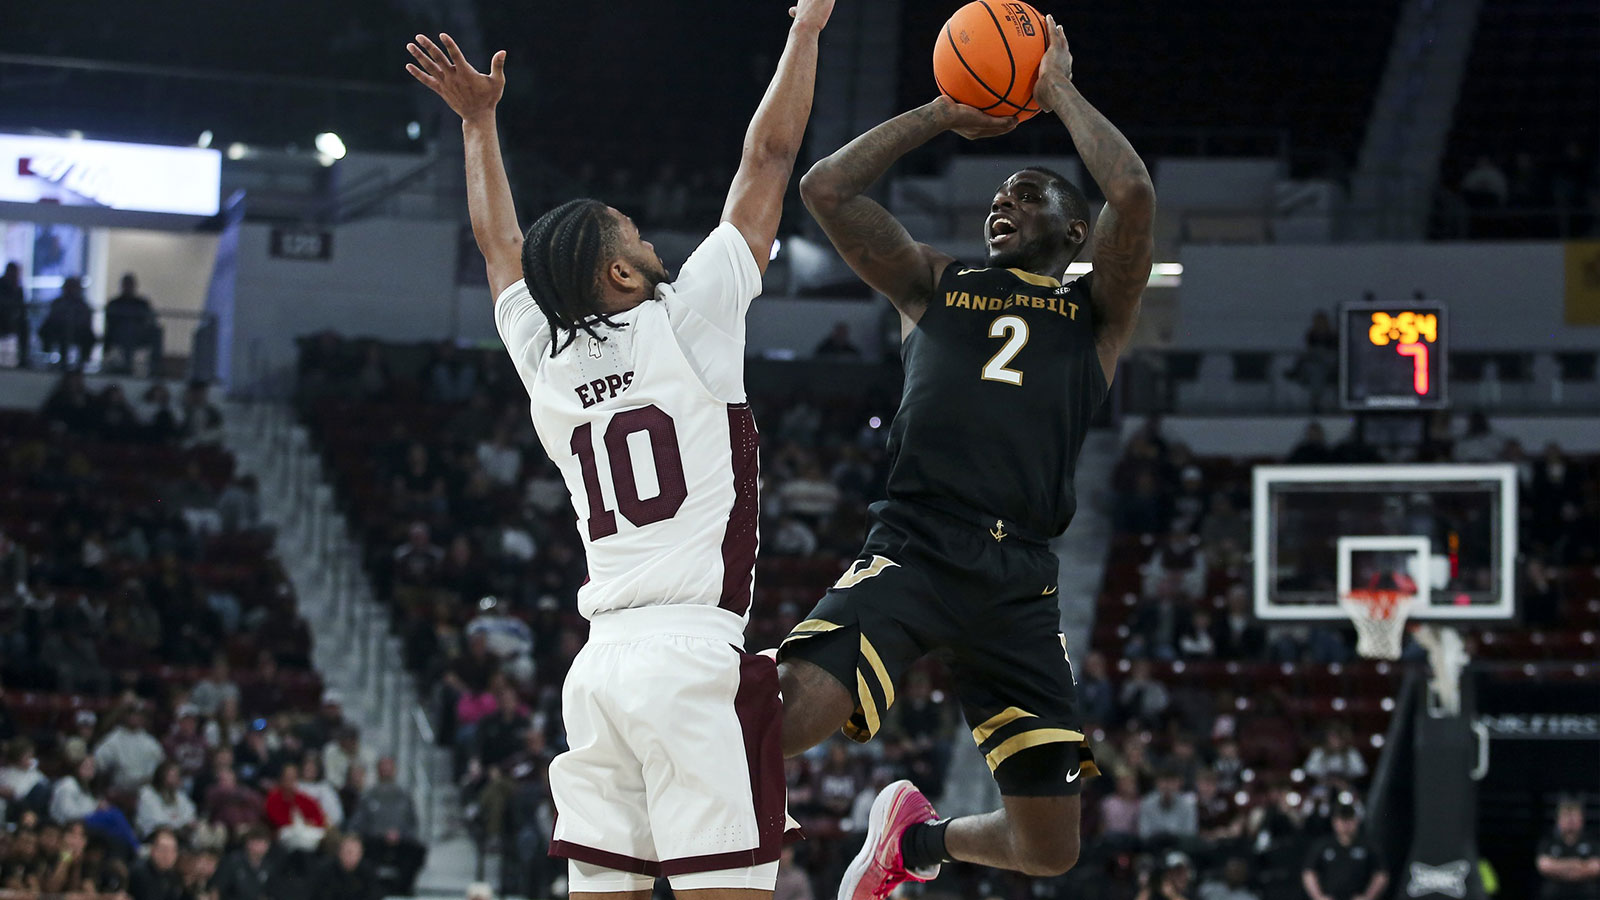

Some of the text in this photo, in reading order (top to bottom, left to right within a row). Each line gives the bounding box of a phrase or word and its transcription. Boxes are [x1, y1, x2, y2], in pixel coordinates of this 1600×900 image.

[1009, 3, 1036, 36] PRO
[945, 290, 1079, 320] VANDERBILT
[1369, 311, 1437, 345] 2:54
[981, 314, 1030, 386] 2
[1396, 342, 1429, 395] 7
[570, 403, 688, 542] 10
